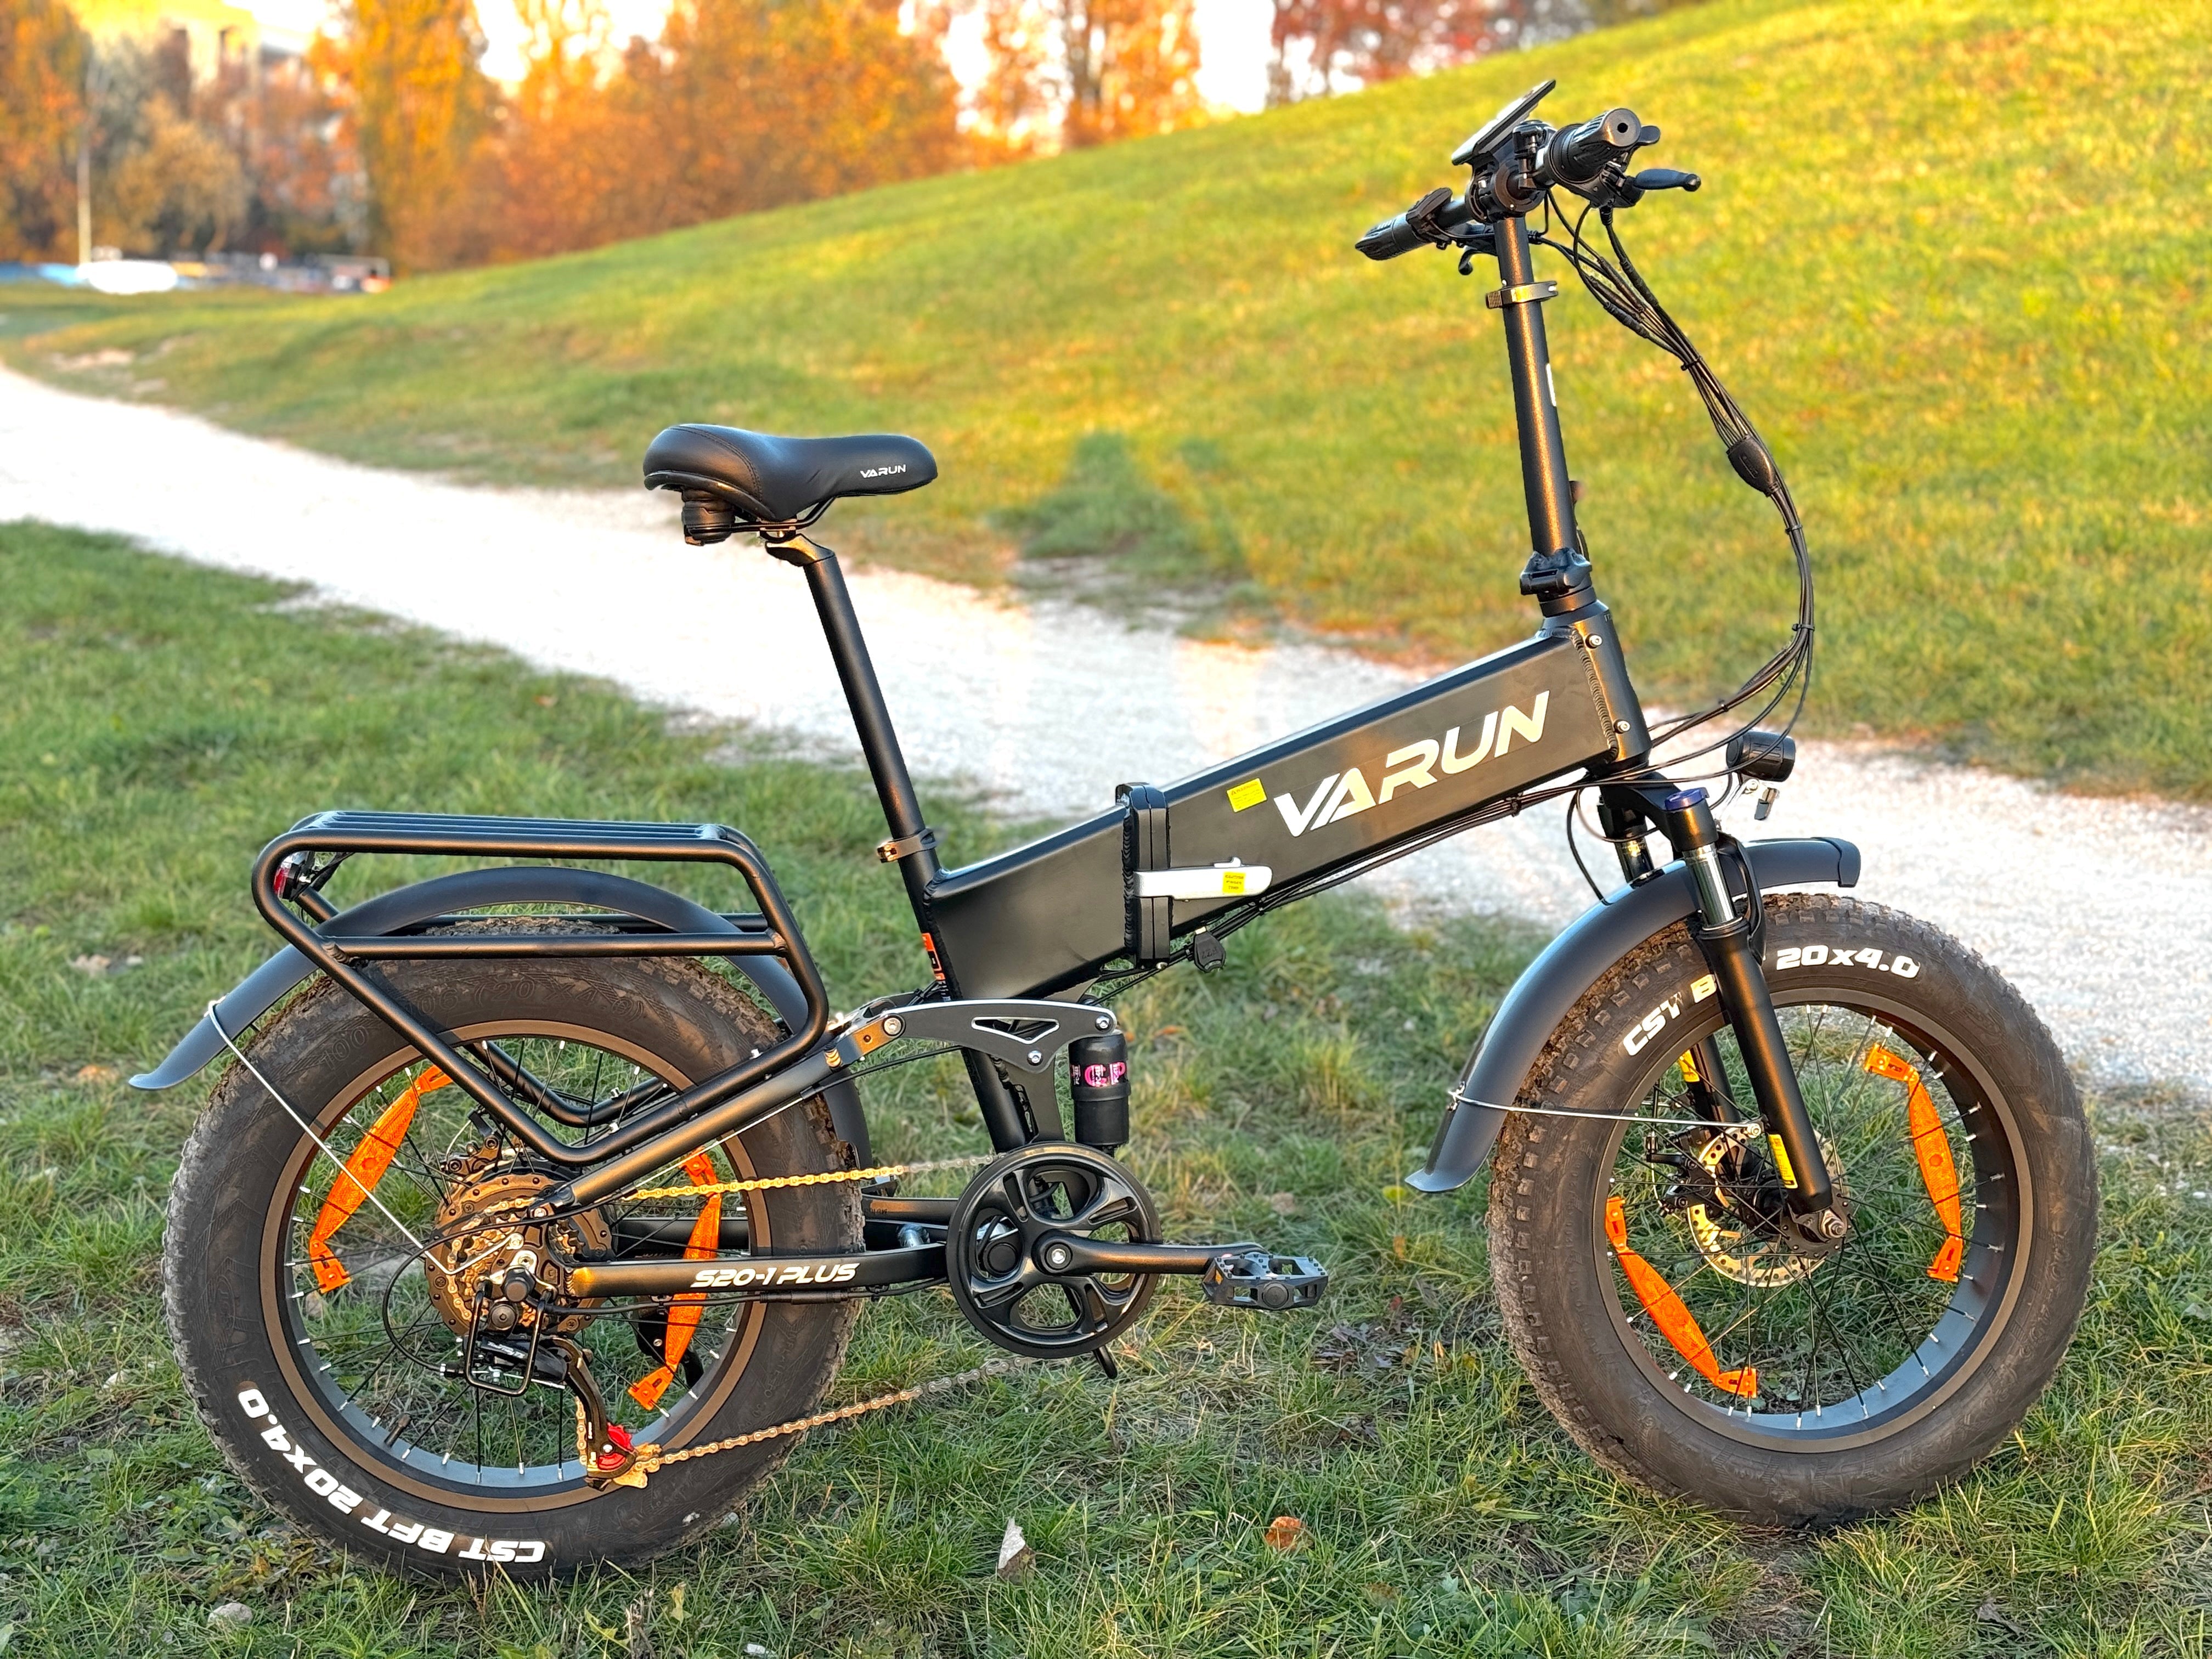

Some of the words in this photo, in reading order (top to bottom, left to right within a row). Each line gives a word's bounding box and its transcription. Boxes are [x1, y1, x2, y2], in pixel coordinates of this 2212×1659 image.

[860, 464, 906, 478] VARUN
[1273, 690, 1550, 837] VARUN
[1622, 992, 1681, 1056] CST
[1690, 974, 1717, 1004] B
[690, 1267, 777, 1288] S20-1
[776, 1263, 860, 1285] PLUS
[361, 1509, 455, 1554] BFT
[459, 1538, 546, 1563] CST
